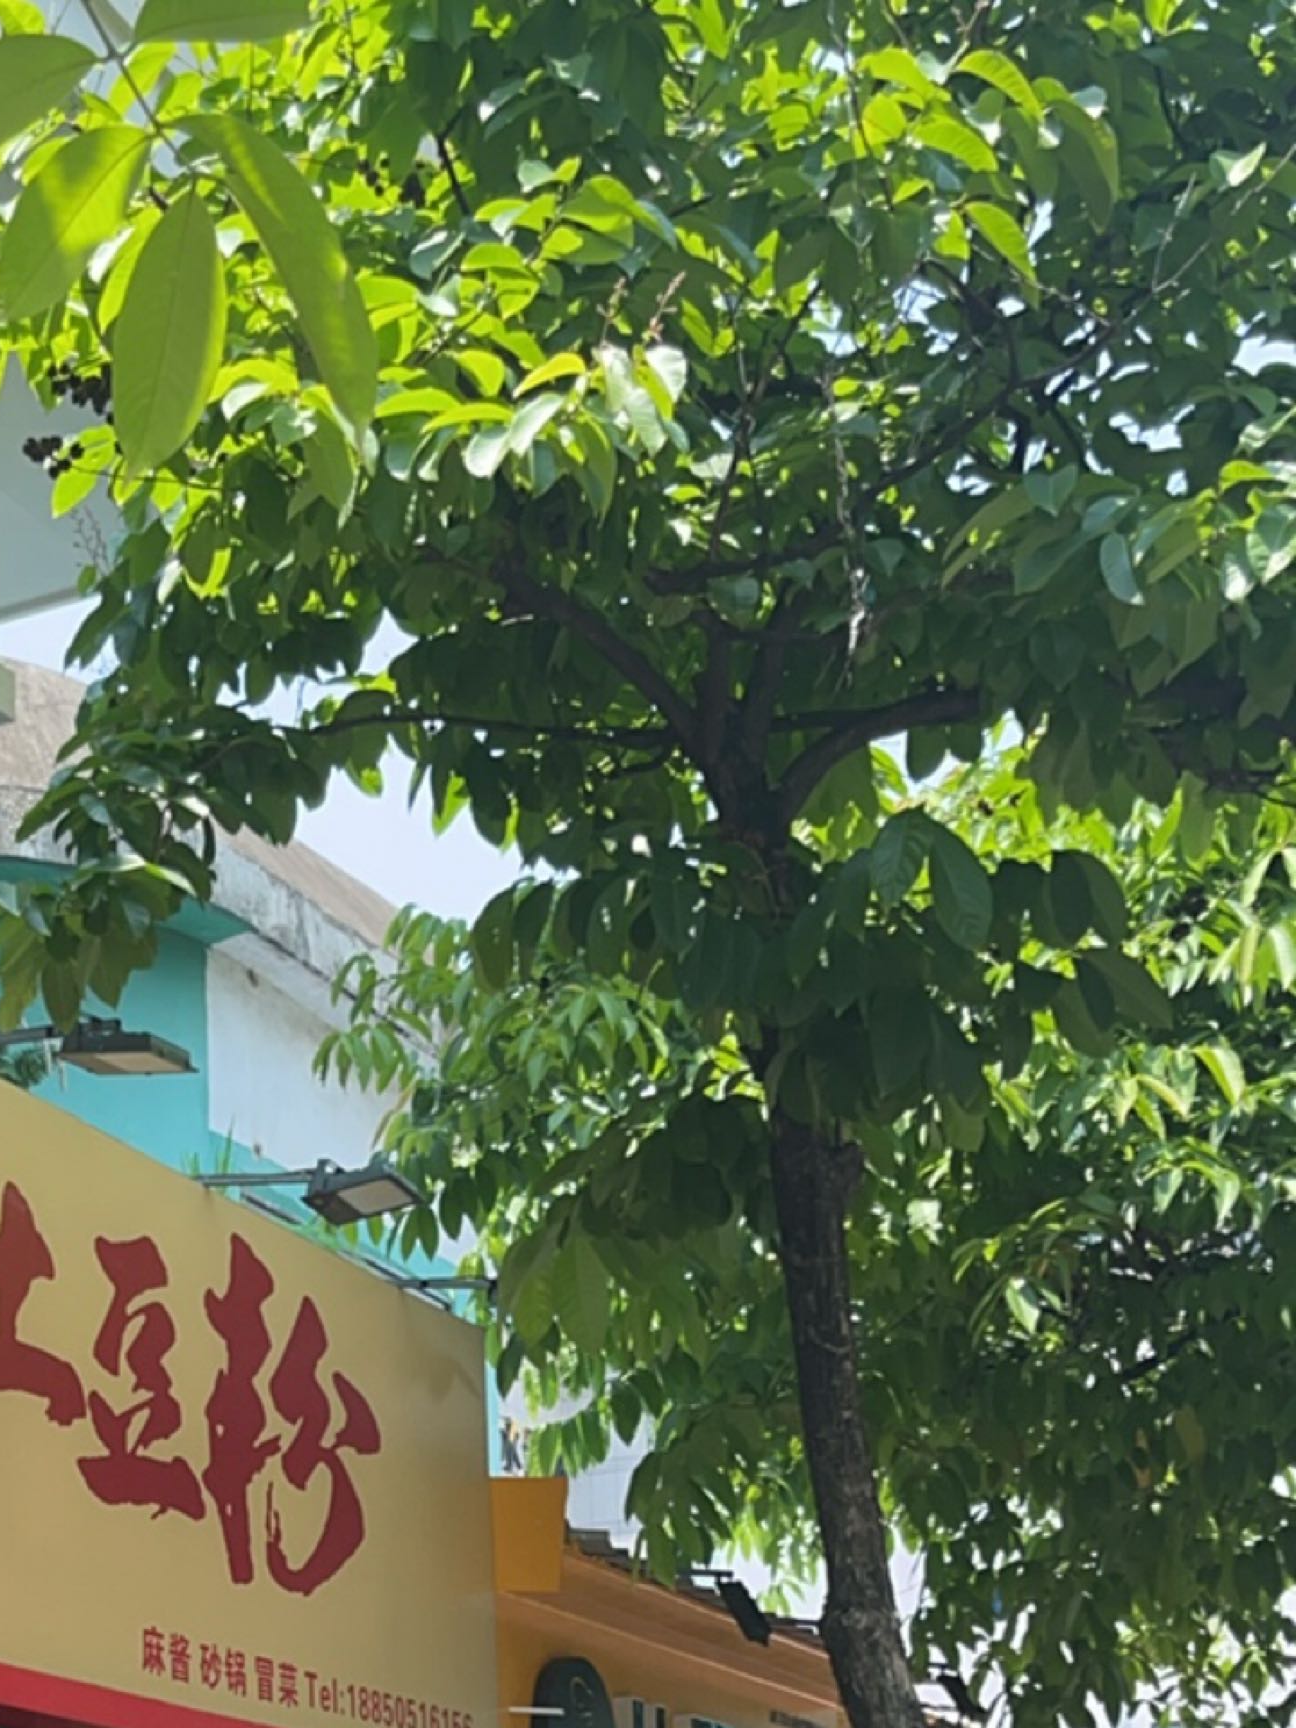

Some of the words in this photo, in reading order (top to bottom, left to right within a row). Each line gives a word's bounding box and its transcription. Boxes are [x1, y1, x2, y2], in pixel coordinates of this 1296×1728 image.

[142, 1626, 191, 1685] 麻酱
[199, 1643, 247, 1698] 砂锅
[254, 1655, 299, 1708] 冒菜
